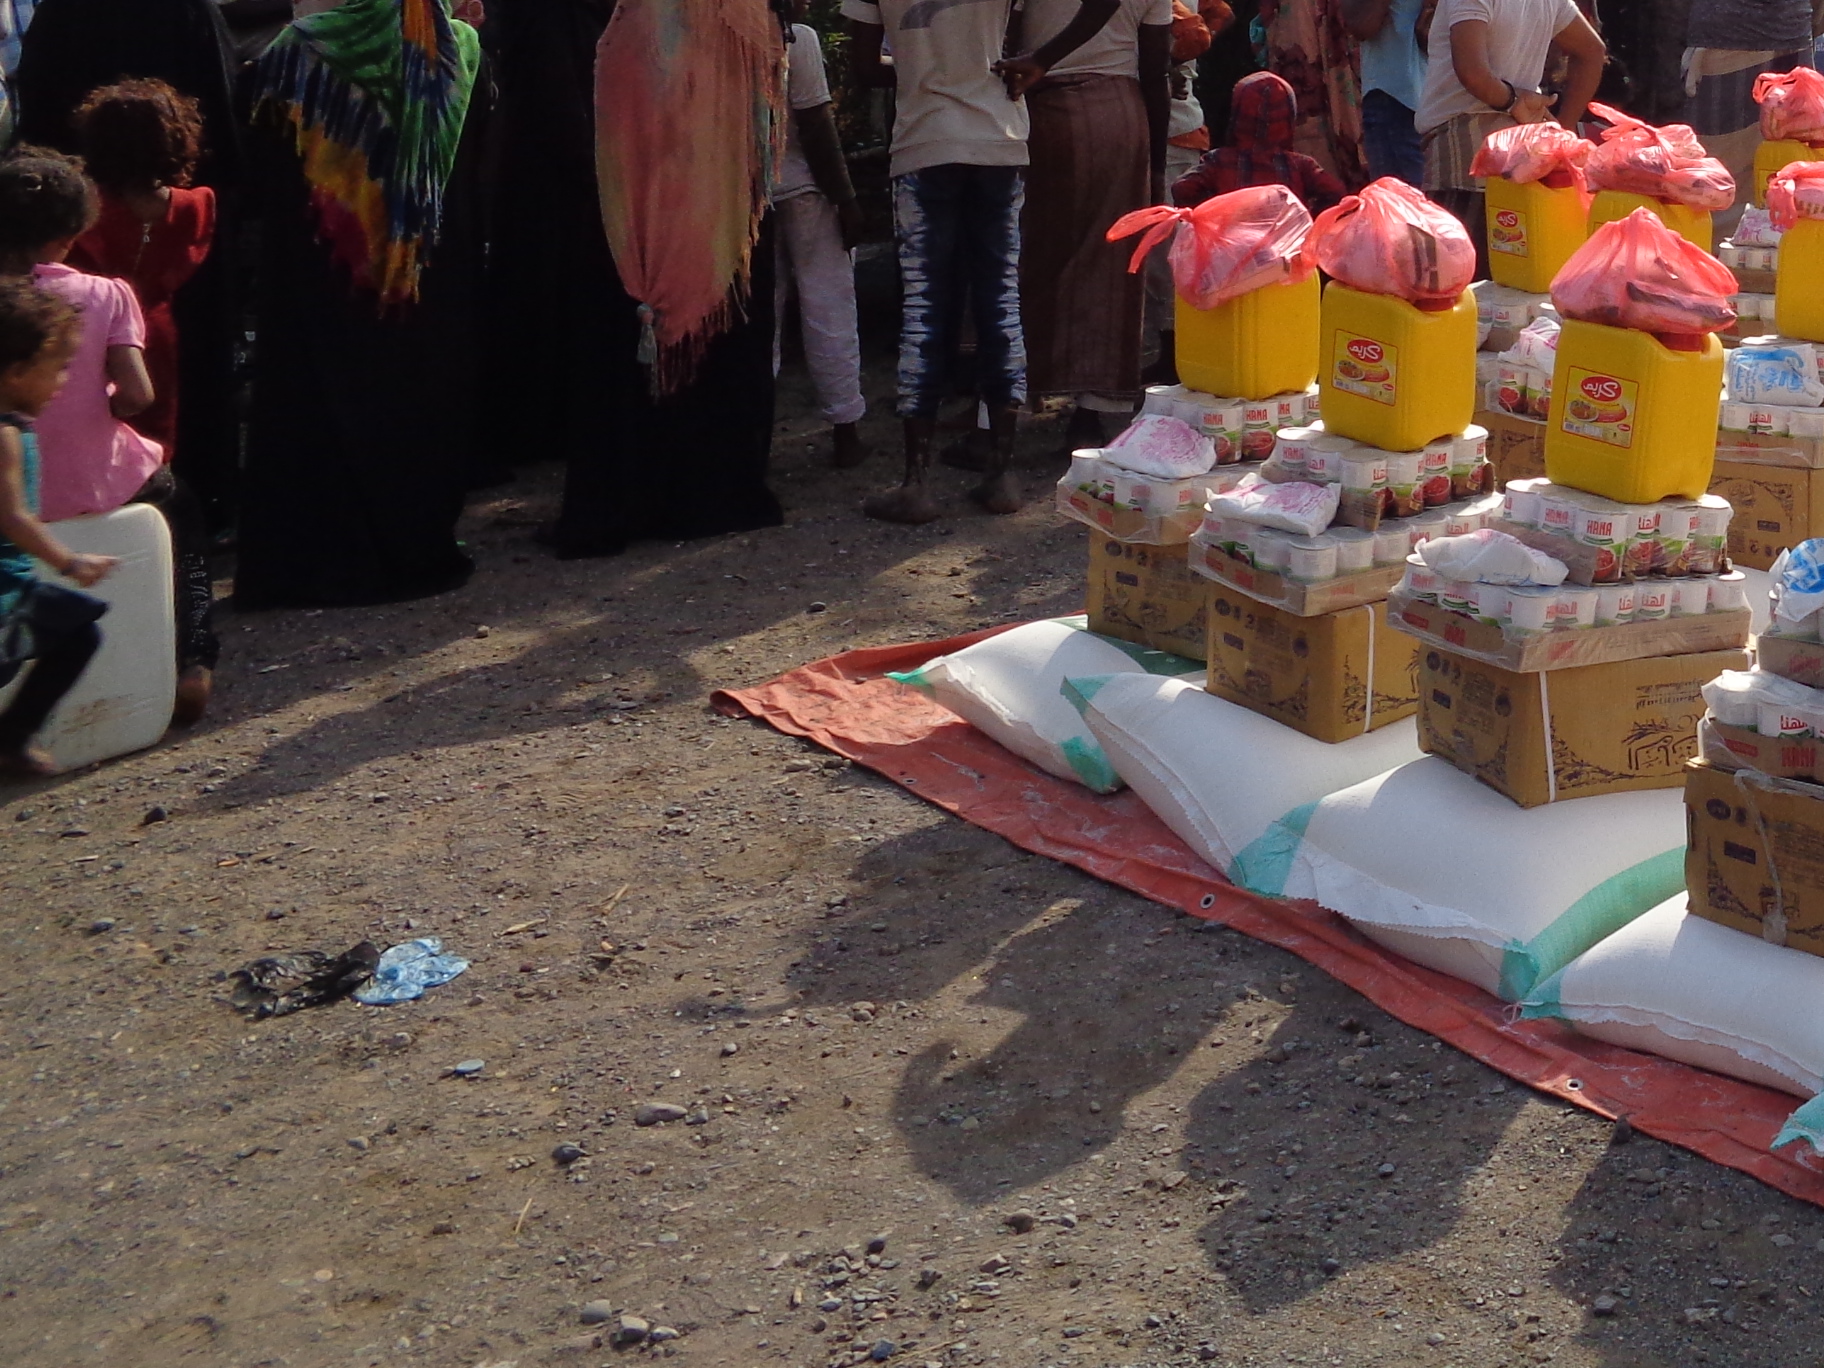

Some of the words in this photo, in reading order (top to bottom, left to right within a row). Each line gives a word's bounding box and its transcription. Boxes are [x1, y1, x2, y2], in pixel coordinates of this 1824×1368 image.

[1498, 212, 1517, 226] كريم
[1350, 343, 1381, 360] كريم
[1583, 382, 1618, 399] كريم
[1203, 413, 1224, 426] HANA
[1246, 408, 1269, 422] HANA
[1425, 451, 1447, 465] HANA
[1586, 519, 1613, 537] HANA
